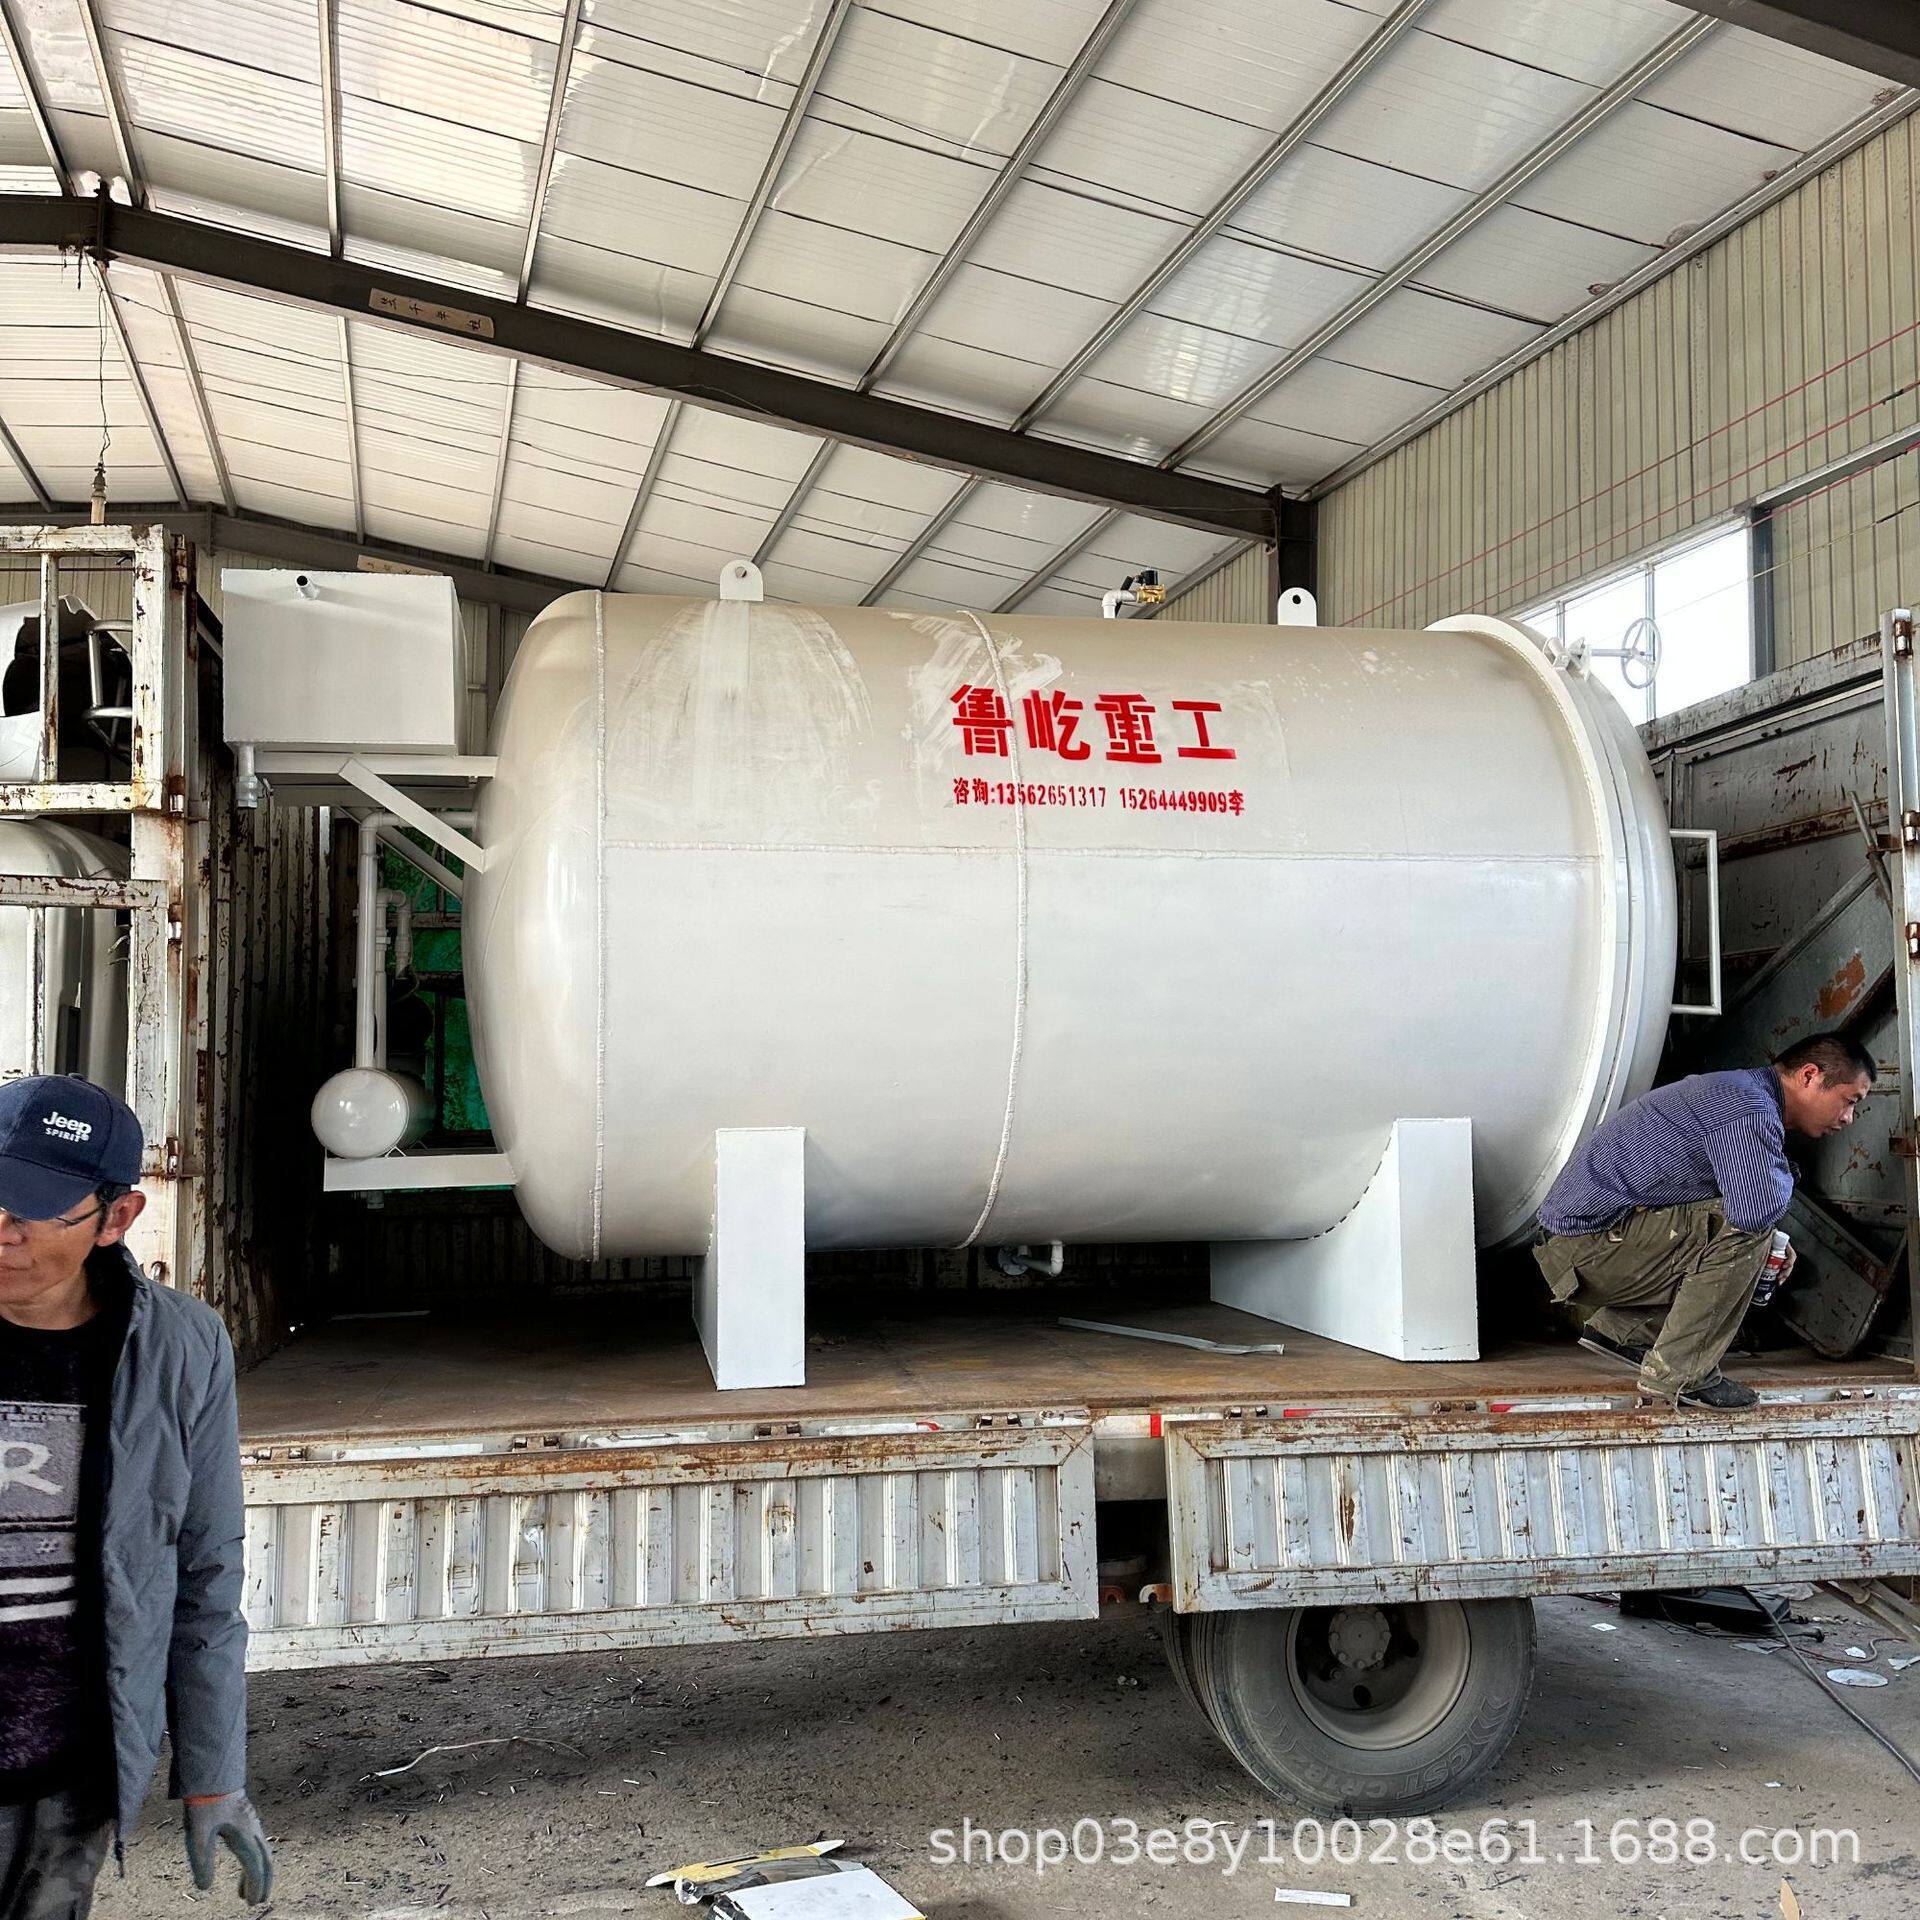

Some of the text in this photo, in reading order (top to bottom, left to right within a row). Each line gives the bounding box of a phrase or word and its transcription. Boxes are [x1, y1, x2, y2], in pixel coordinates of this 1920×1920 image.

[950, 684, 1237, 763] 鲁屹重工
[1119, 788, 1245, 816] 15264449909李
[43, 1111, 92, 1134] Jeep
[45, 1127, 82, 1143] SPIRIT
